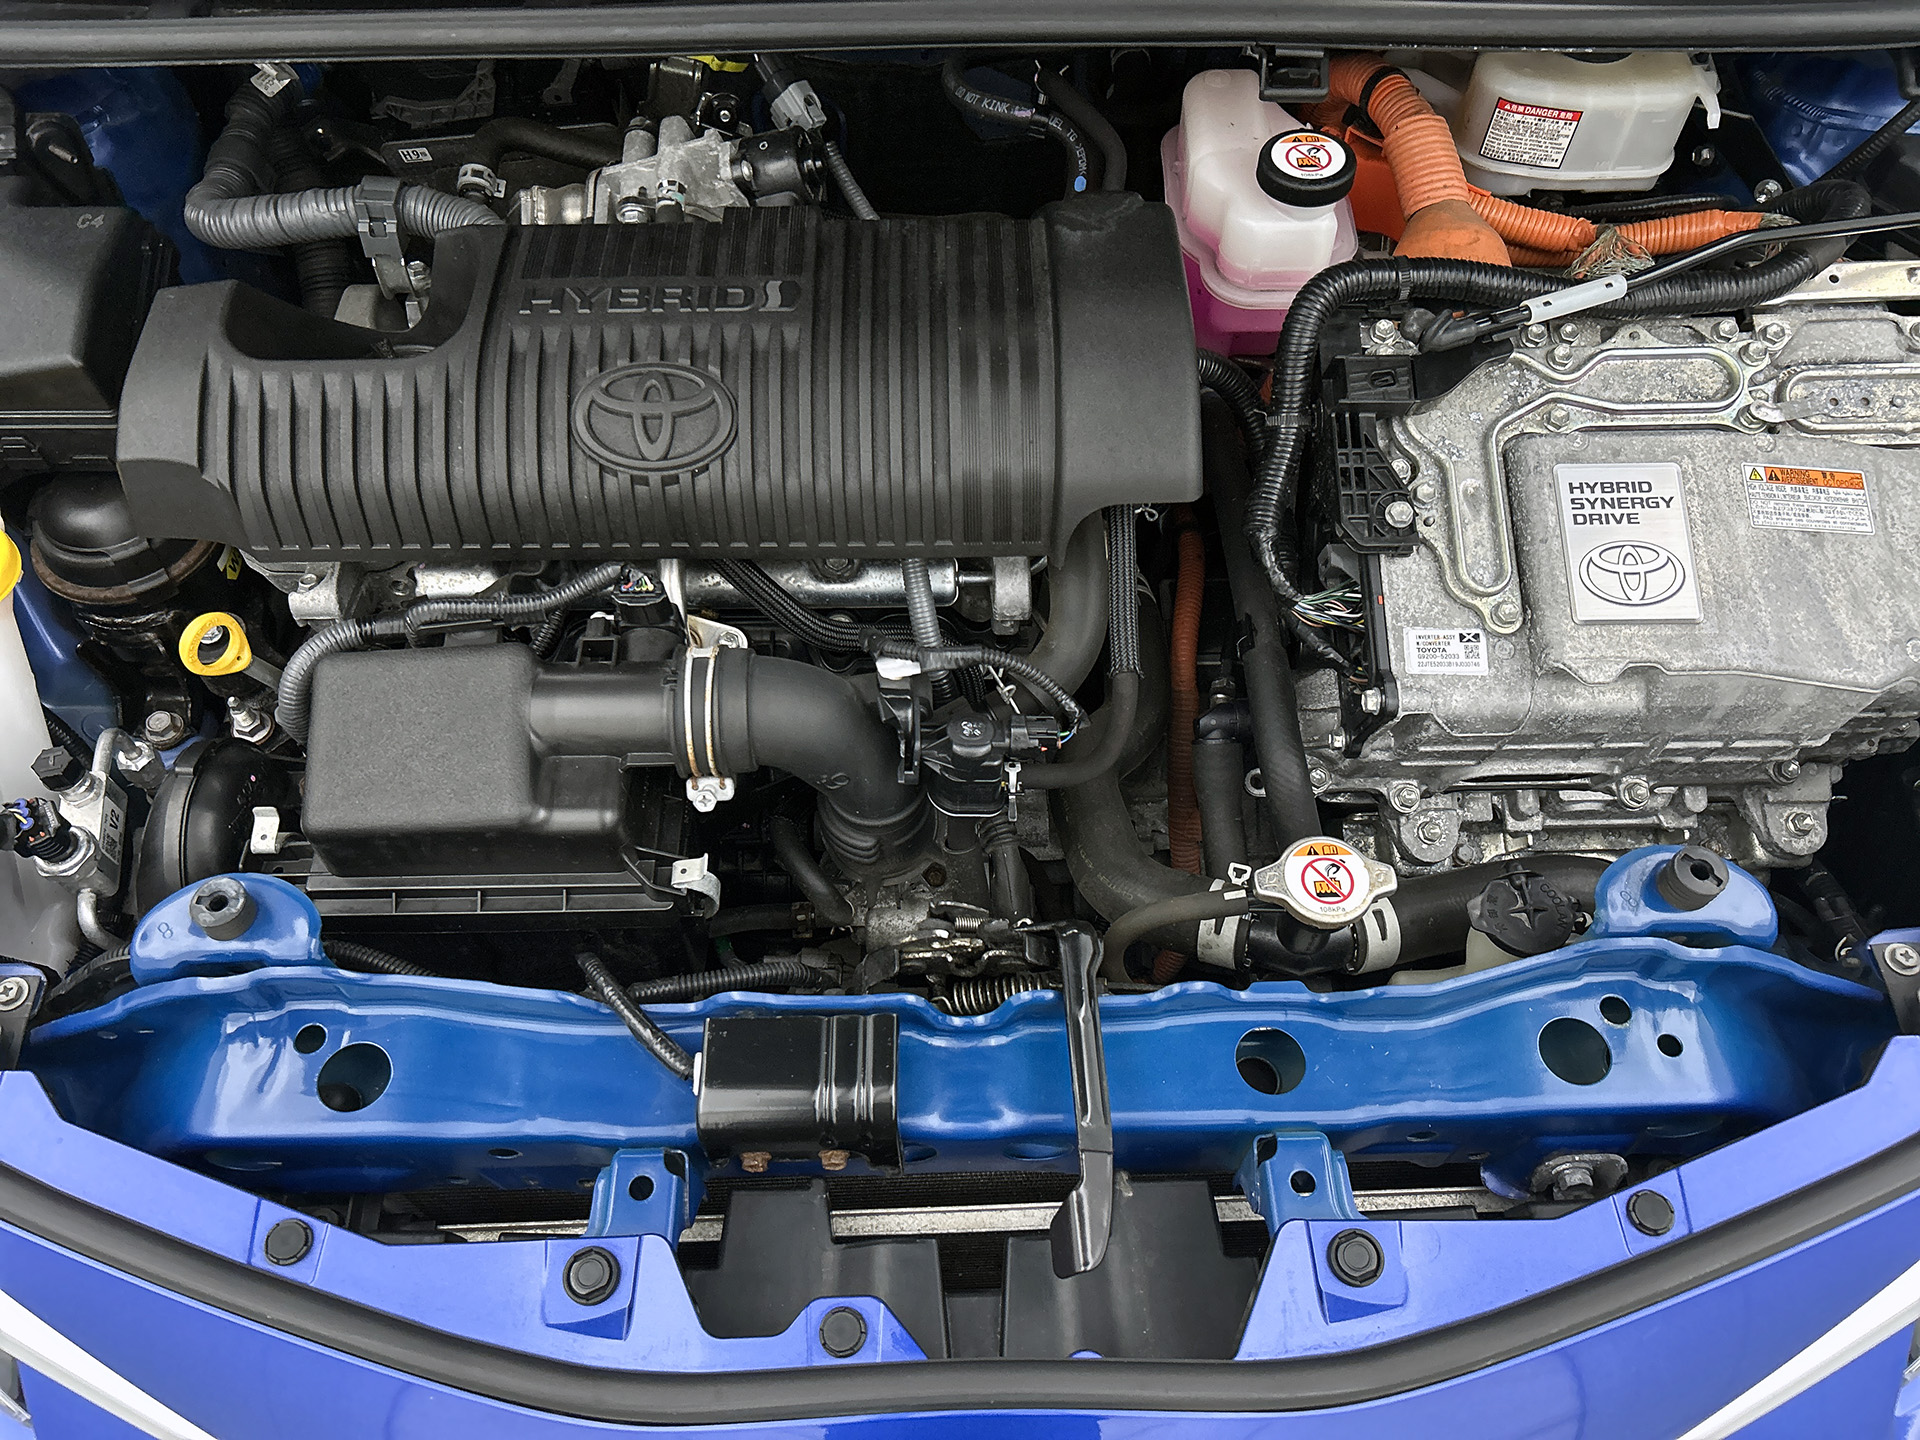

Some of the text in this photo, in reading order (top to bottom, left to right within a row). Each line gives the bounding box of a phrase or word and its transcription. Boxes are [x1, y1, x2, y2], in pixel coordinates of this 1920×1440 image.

[981, 97, 1010, 114] KINK
[1525, 106, 1559, 118] DANGER
[400, 149, 420, 160] H9
[76, 213, 105, 230] C4
[518, 285, 755, 315] HYBRID
[1780, 469, 1810, 478] WARNING
[1568, 481, 1653, 494] HYBRID
[1570, 496, 1675, 510] SYNERGY
[1572, 513, 1640, 525] DRIVE
[109, 808, 120, 830] V2
[157, 921, 174, 939] 8
